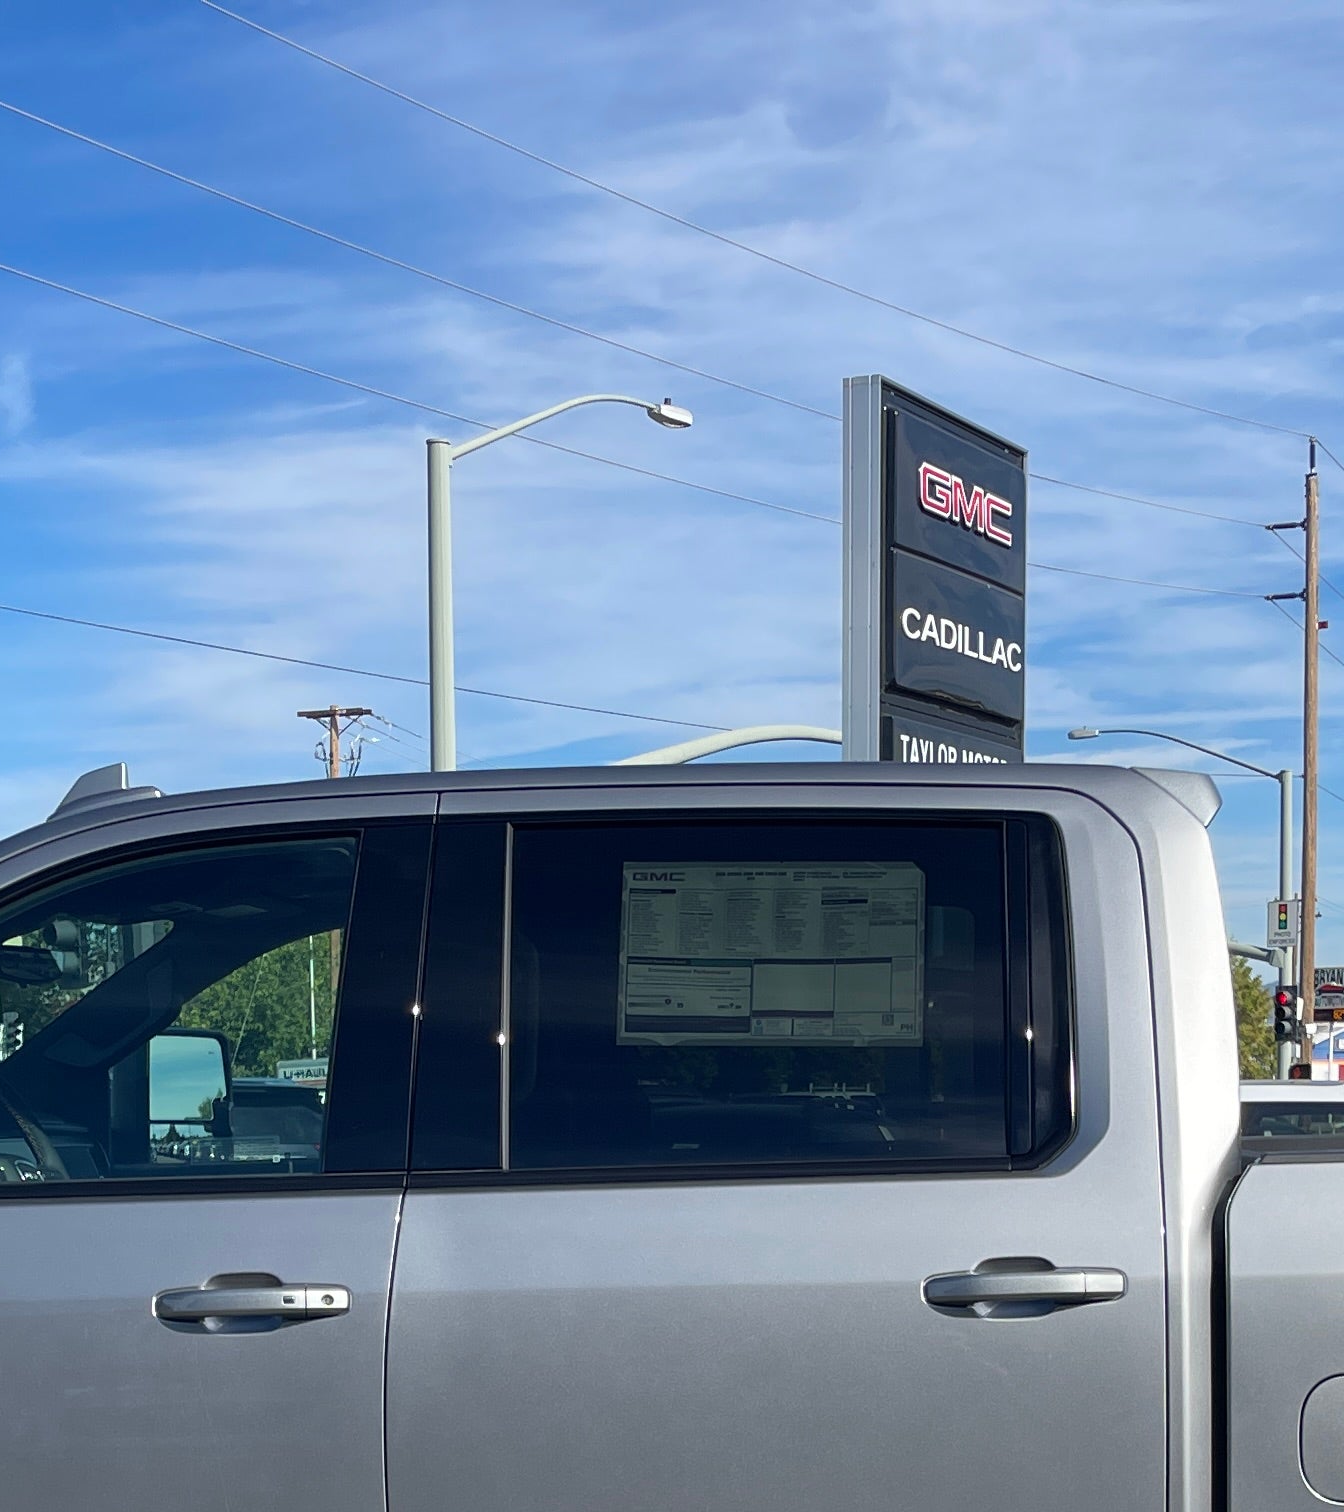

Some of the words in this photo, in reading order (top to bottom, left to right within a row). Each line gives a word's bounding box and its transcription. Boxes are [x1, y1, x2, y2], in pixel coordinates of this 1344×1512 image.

[918, 462, 1012, 547] GMC
[901, 607, 1022, 672] CADILLAC
[632, 872, 685, 882] GMC
